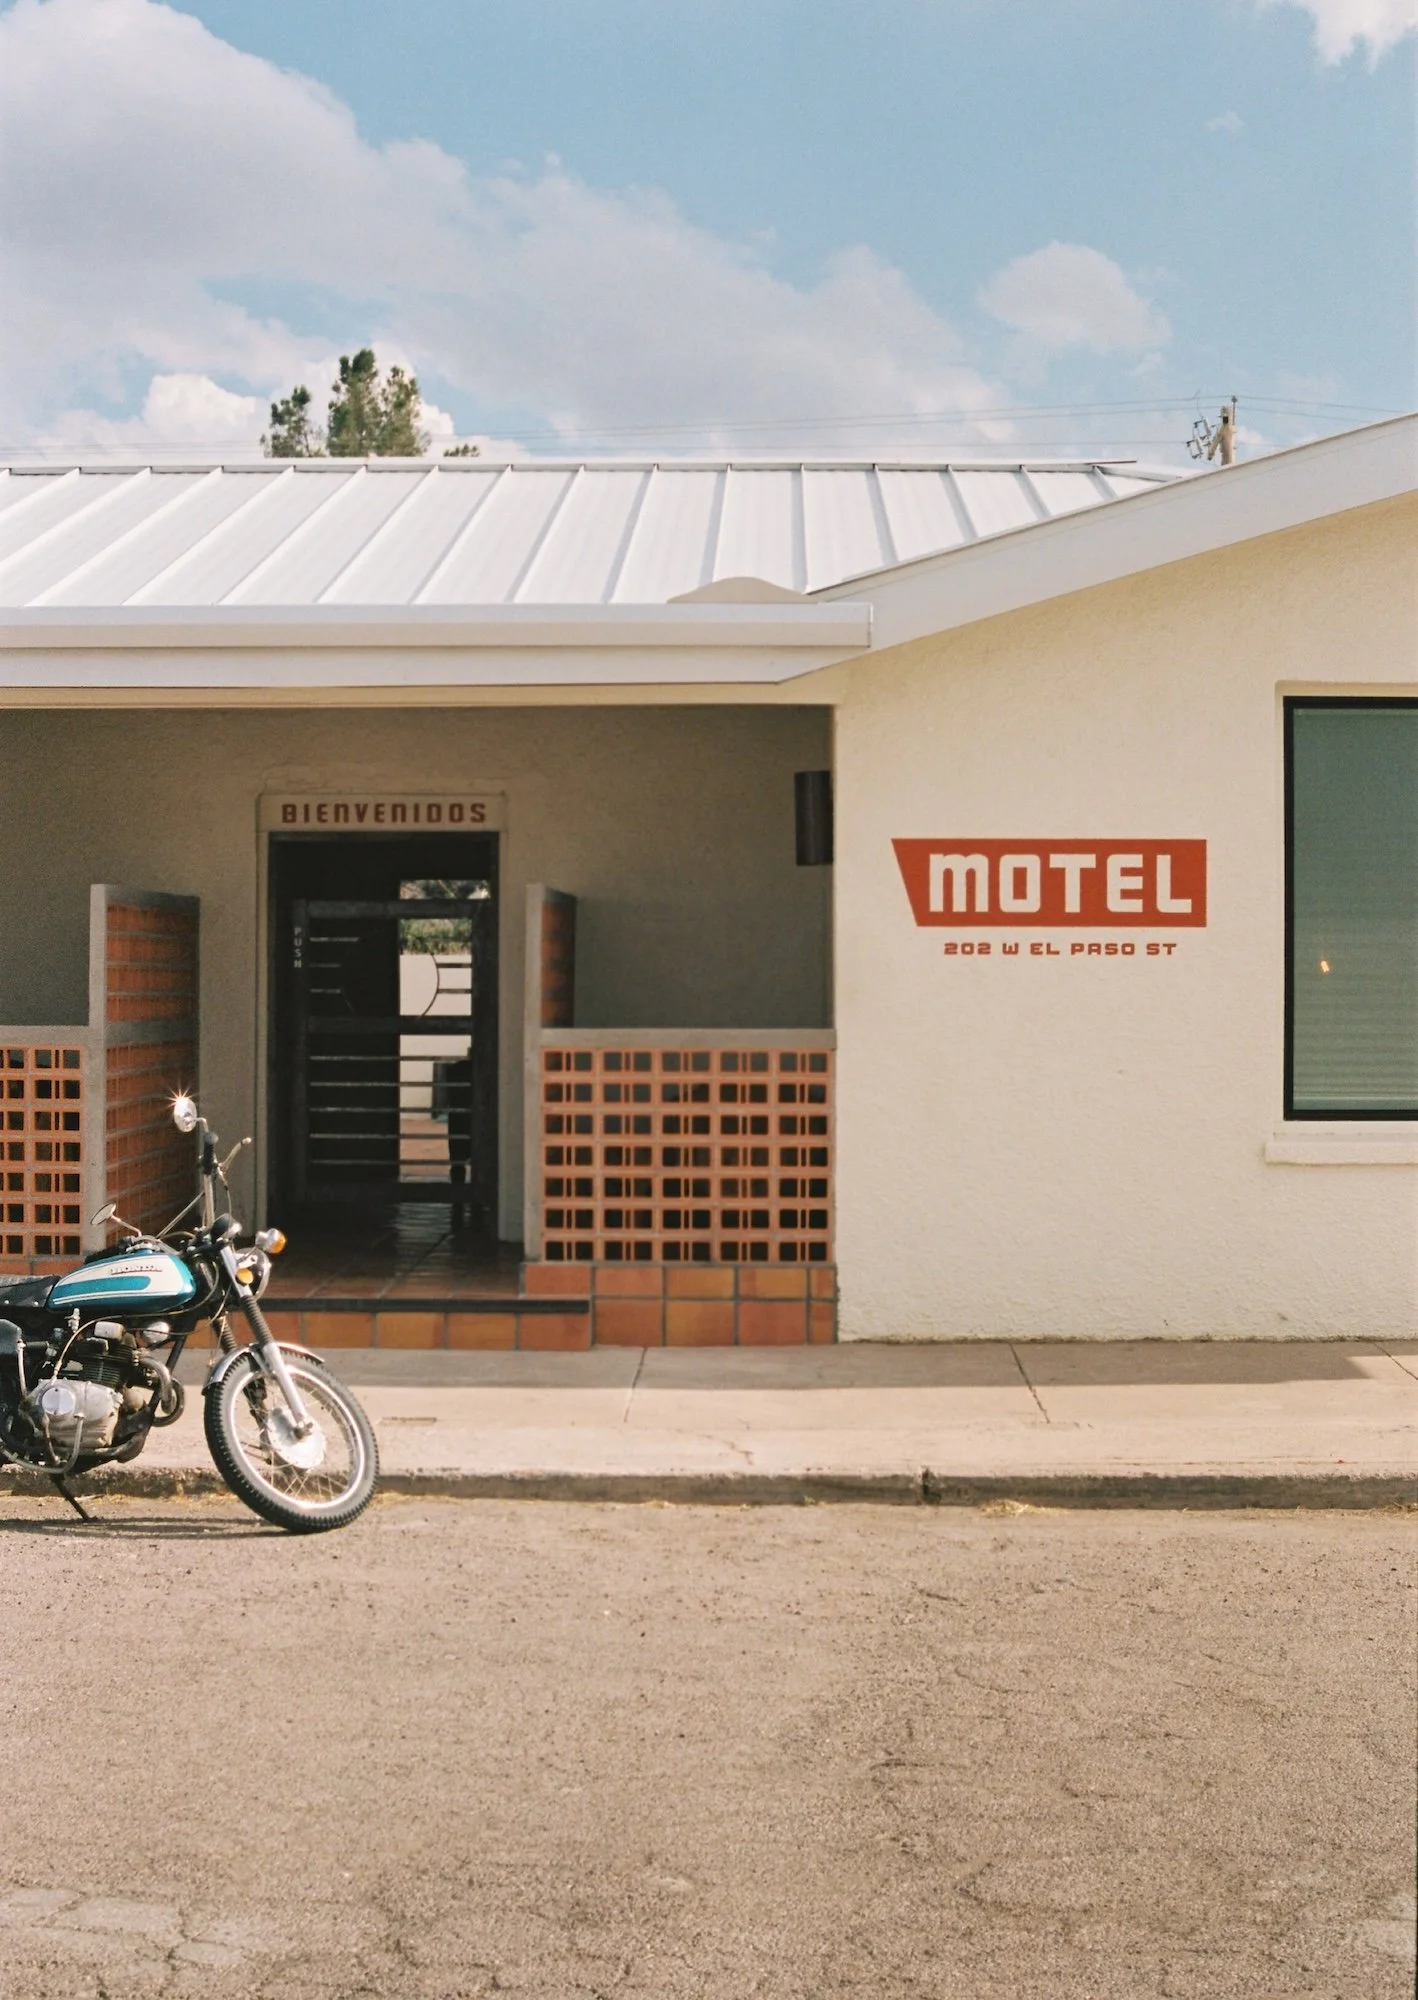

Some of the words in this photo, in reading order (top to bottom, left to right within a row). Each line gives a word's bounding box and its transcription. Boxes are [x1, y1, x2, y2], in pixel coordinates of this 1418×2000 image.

[281, 802, 487, 824] BIENVENIDOS
[928, 853, 1193, 914] MOTEL
[293, 926, 303, 969] PUSH
[944, 942, 992, 956] 202
[1001, 942, 1020, 955] W
[1030, 942, 1061, 956] EL
[1070, 942, 1136, 956] PASO
[1145, 942, 1178, 956] ST
